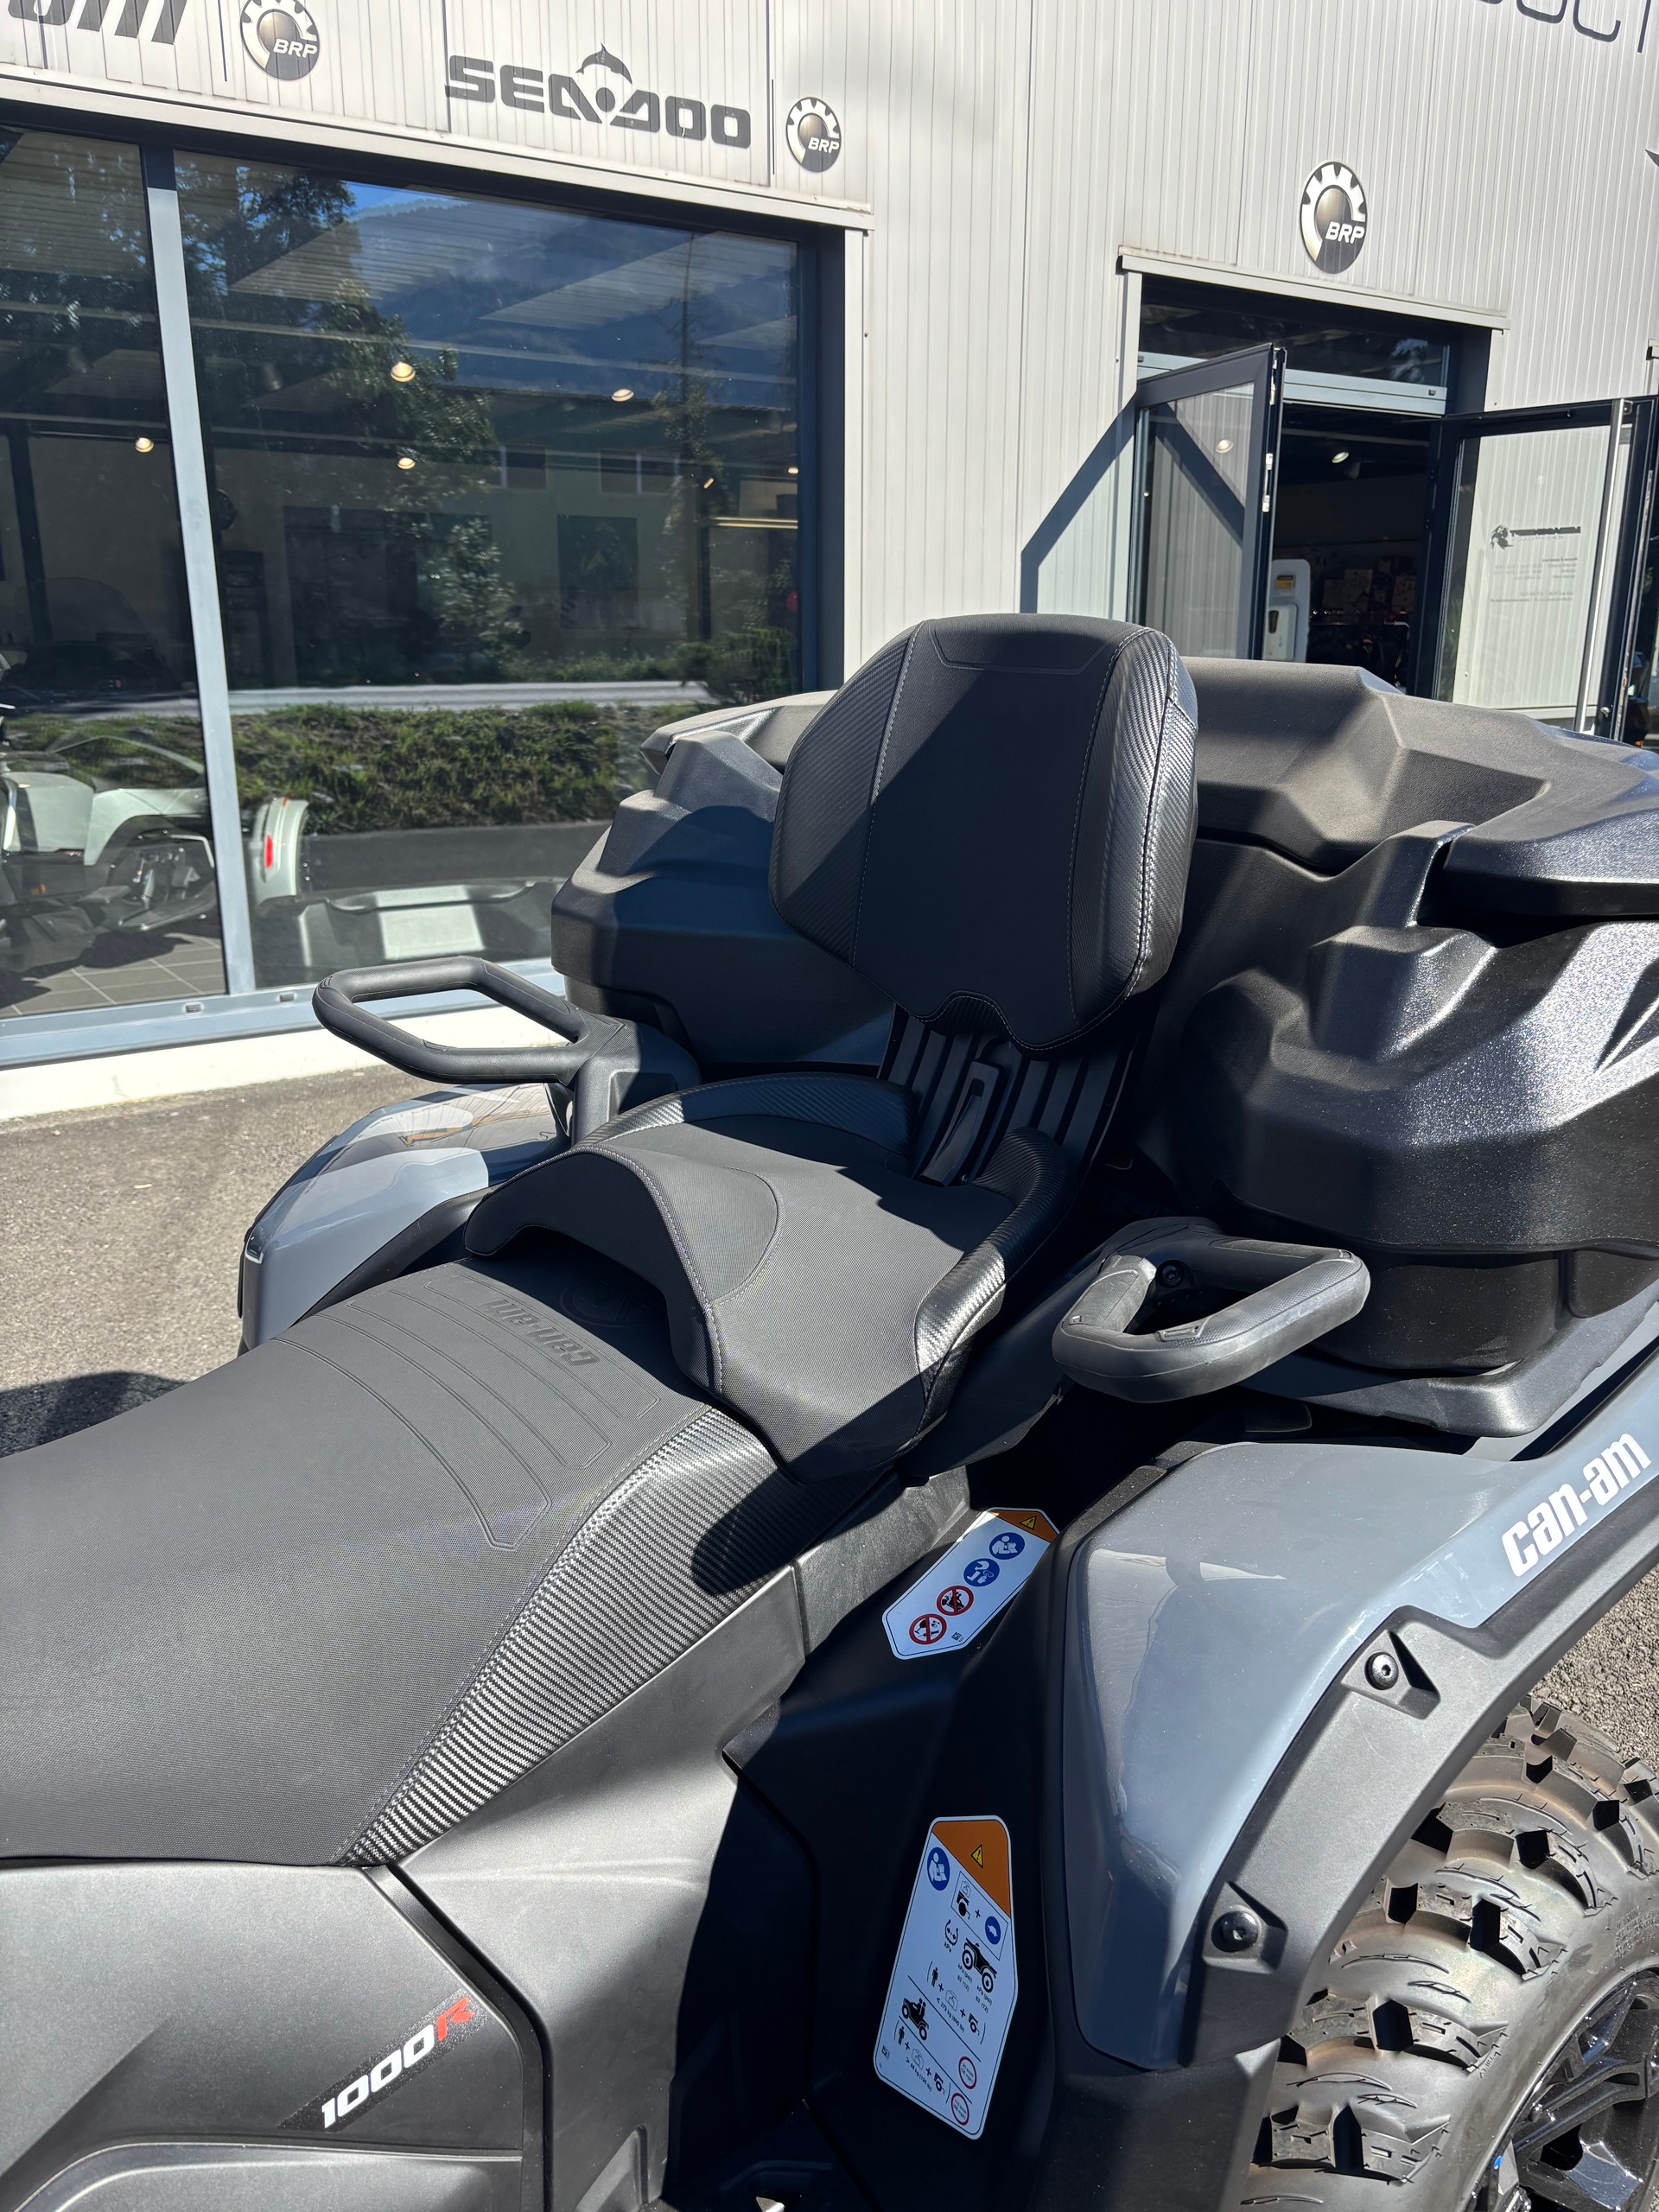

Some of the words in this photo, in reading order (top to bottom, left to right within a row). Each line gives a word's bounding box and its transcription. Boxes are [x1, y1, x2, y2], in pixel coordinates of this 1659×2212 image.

[273, 38, 318, 59] BRP
[808, 137, 841, 154] BRP
[1325, 221, 1365, 245] BRP
[1502, 1433, 1652, 1577] can-am
[321, 1997, 474, 2129] 1000R
